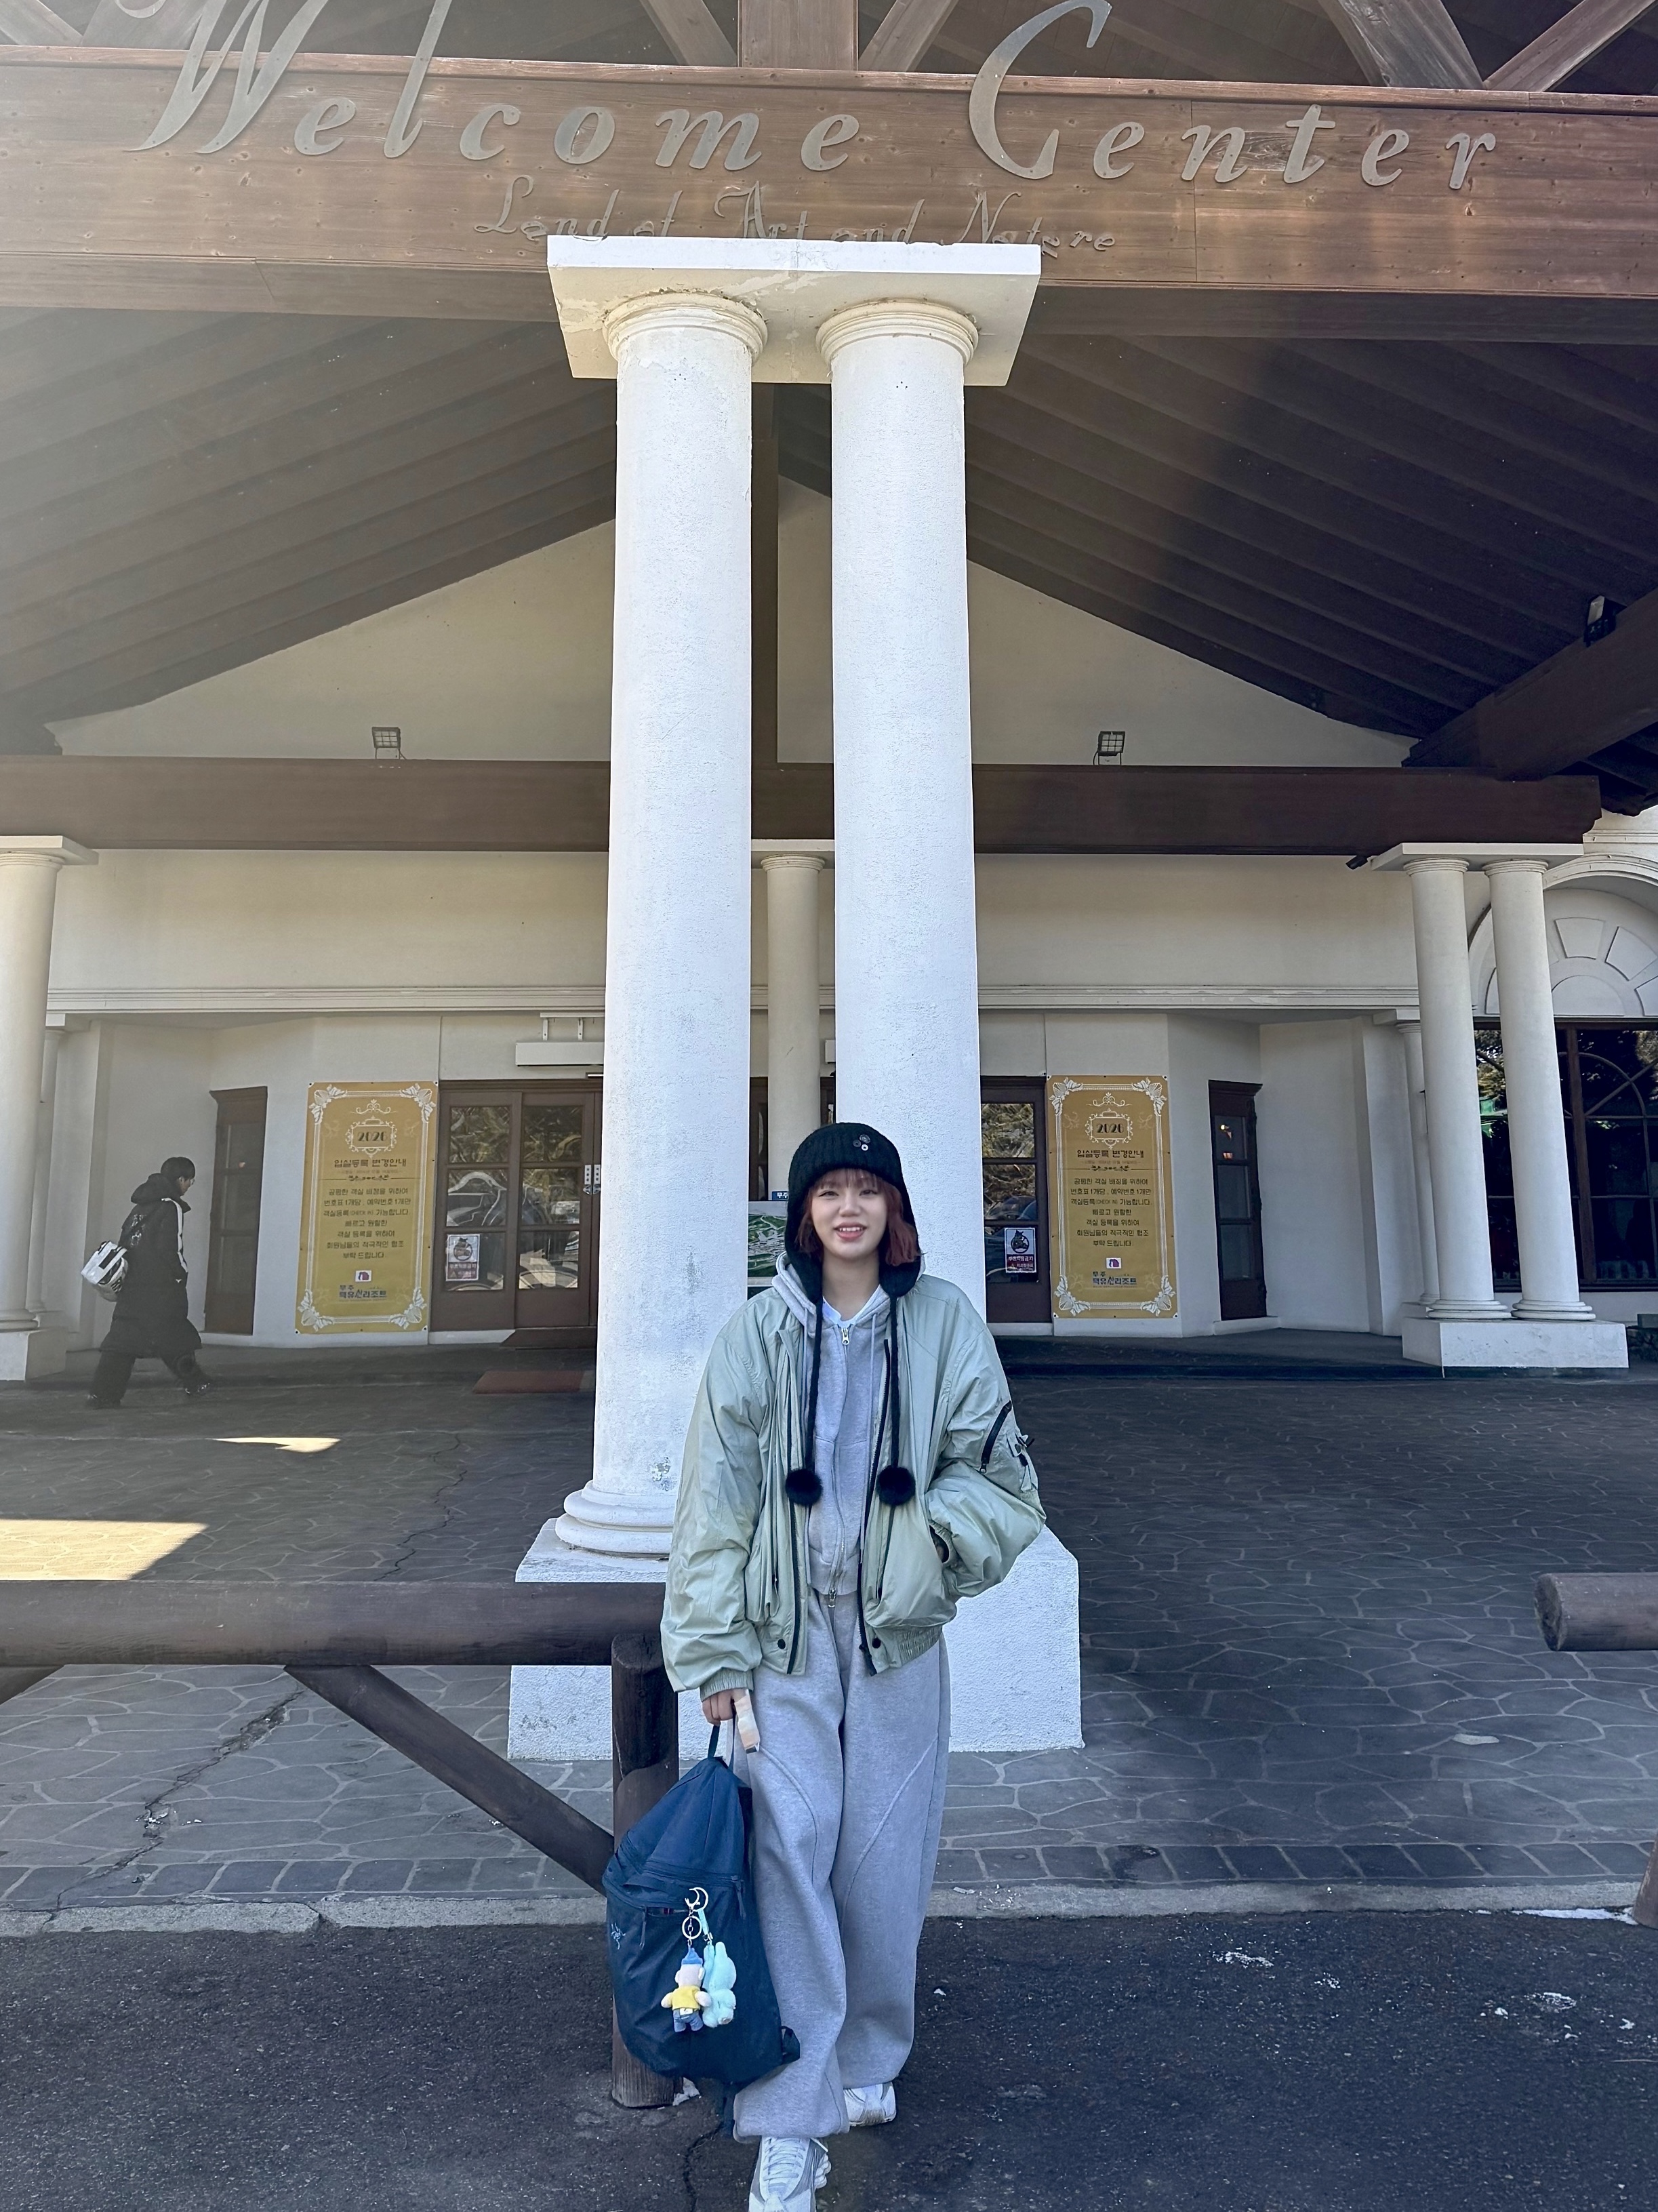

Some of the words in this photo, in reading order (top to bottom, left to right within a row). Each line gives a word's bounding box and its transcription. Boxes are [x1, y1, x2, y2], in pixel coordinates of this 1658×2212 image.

[115, 0, 859, 171] Welcome
[969, 0, 1495, 190] Center
[714, 180, 809, 239] Art
[1096, 1123, 1125, 1133] 2026
[357, 1131, 387, 1142] 2026
[1077, 1150, 1109, 1159] 입실등록
[1112, 1150, 1144, 1159] 변경안내
[334, 1159, 369, 1167] 입실등록
[372, 1159, 407, 1167] 변경안내
[1093, 1276, 1137, 1285] 덕유산리조트
